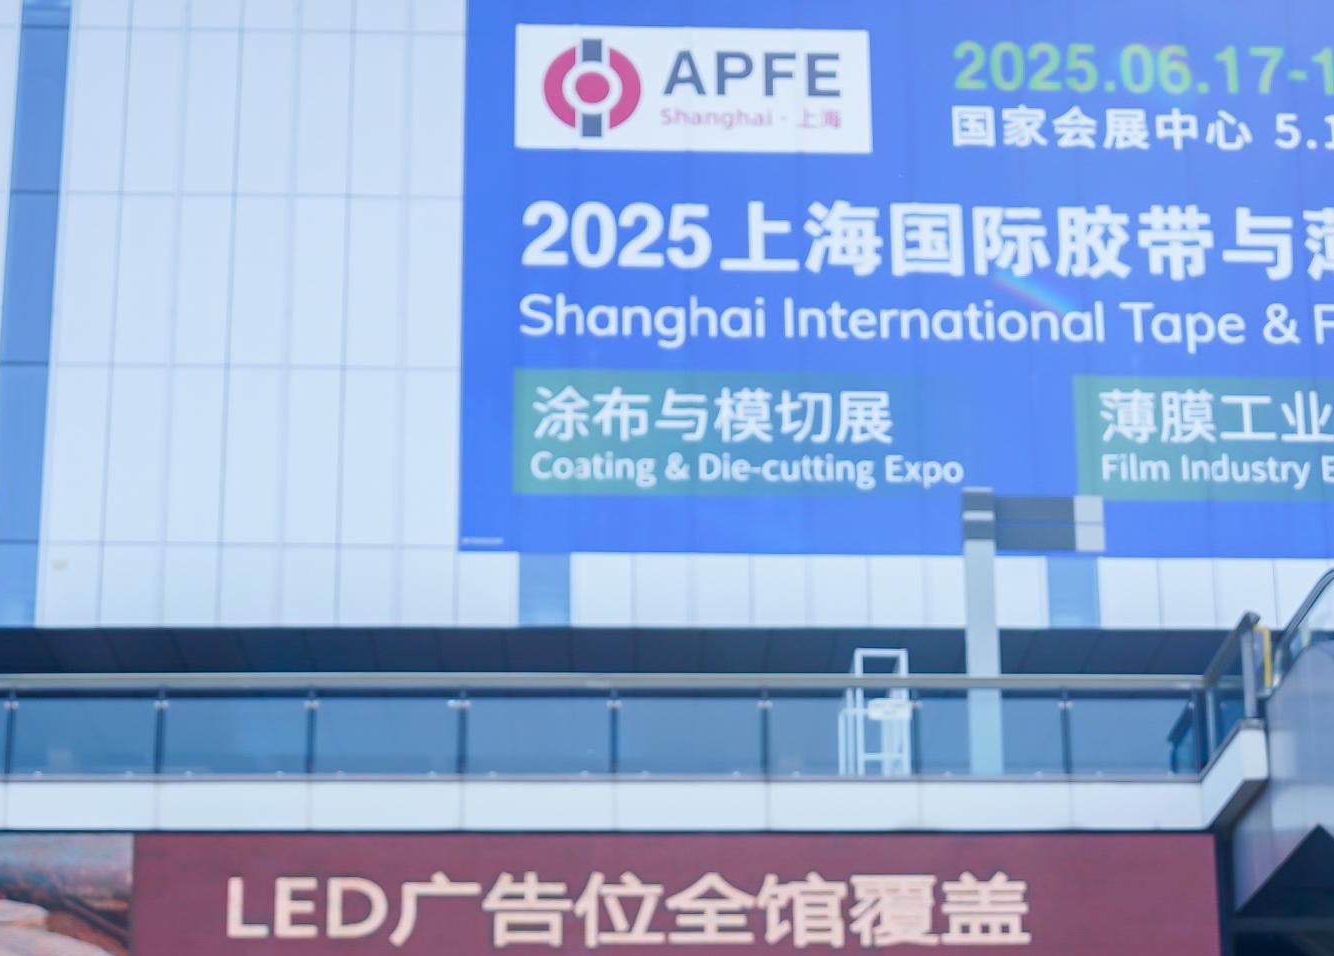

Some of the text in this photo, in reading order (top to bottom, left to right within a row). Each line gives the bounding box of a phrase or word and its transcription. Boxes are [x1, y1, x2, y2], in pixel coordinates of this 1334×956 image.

[663, 50, 841, 97] APFE
[660, 107, 772, 131] Shanghai
[796, 107, 842, 129] 上海
[951, 104, 1252, 151] 国家会展中心
[519, 293, 765, 349] Shanghai
[784, 298, 1104, 342] International
[1122, 303, 1246, 354] Tape
[1263, 304, 1300, 345] &
[533, 385, 893, 444] 涂布与模切展
[530, 450, 964, 490] Coating & Die-cutting Expo
[1102, 453, 1170, 481] Film
[1182, 453, 1310, 490] Industry
[226, 871, 1031, 948] LED广告位全馆覆盖
